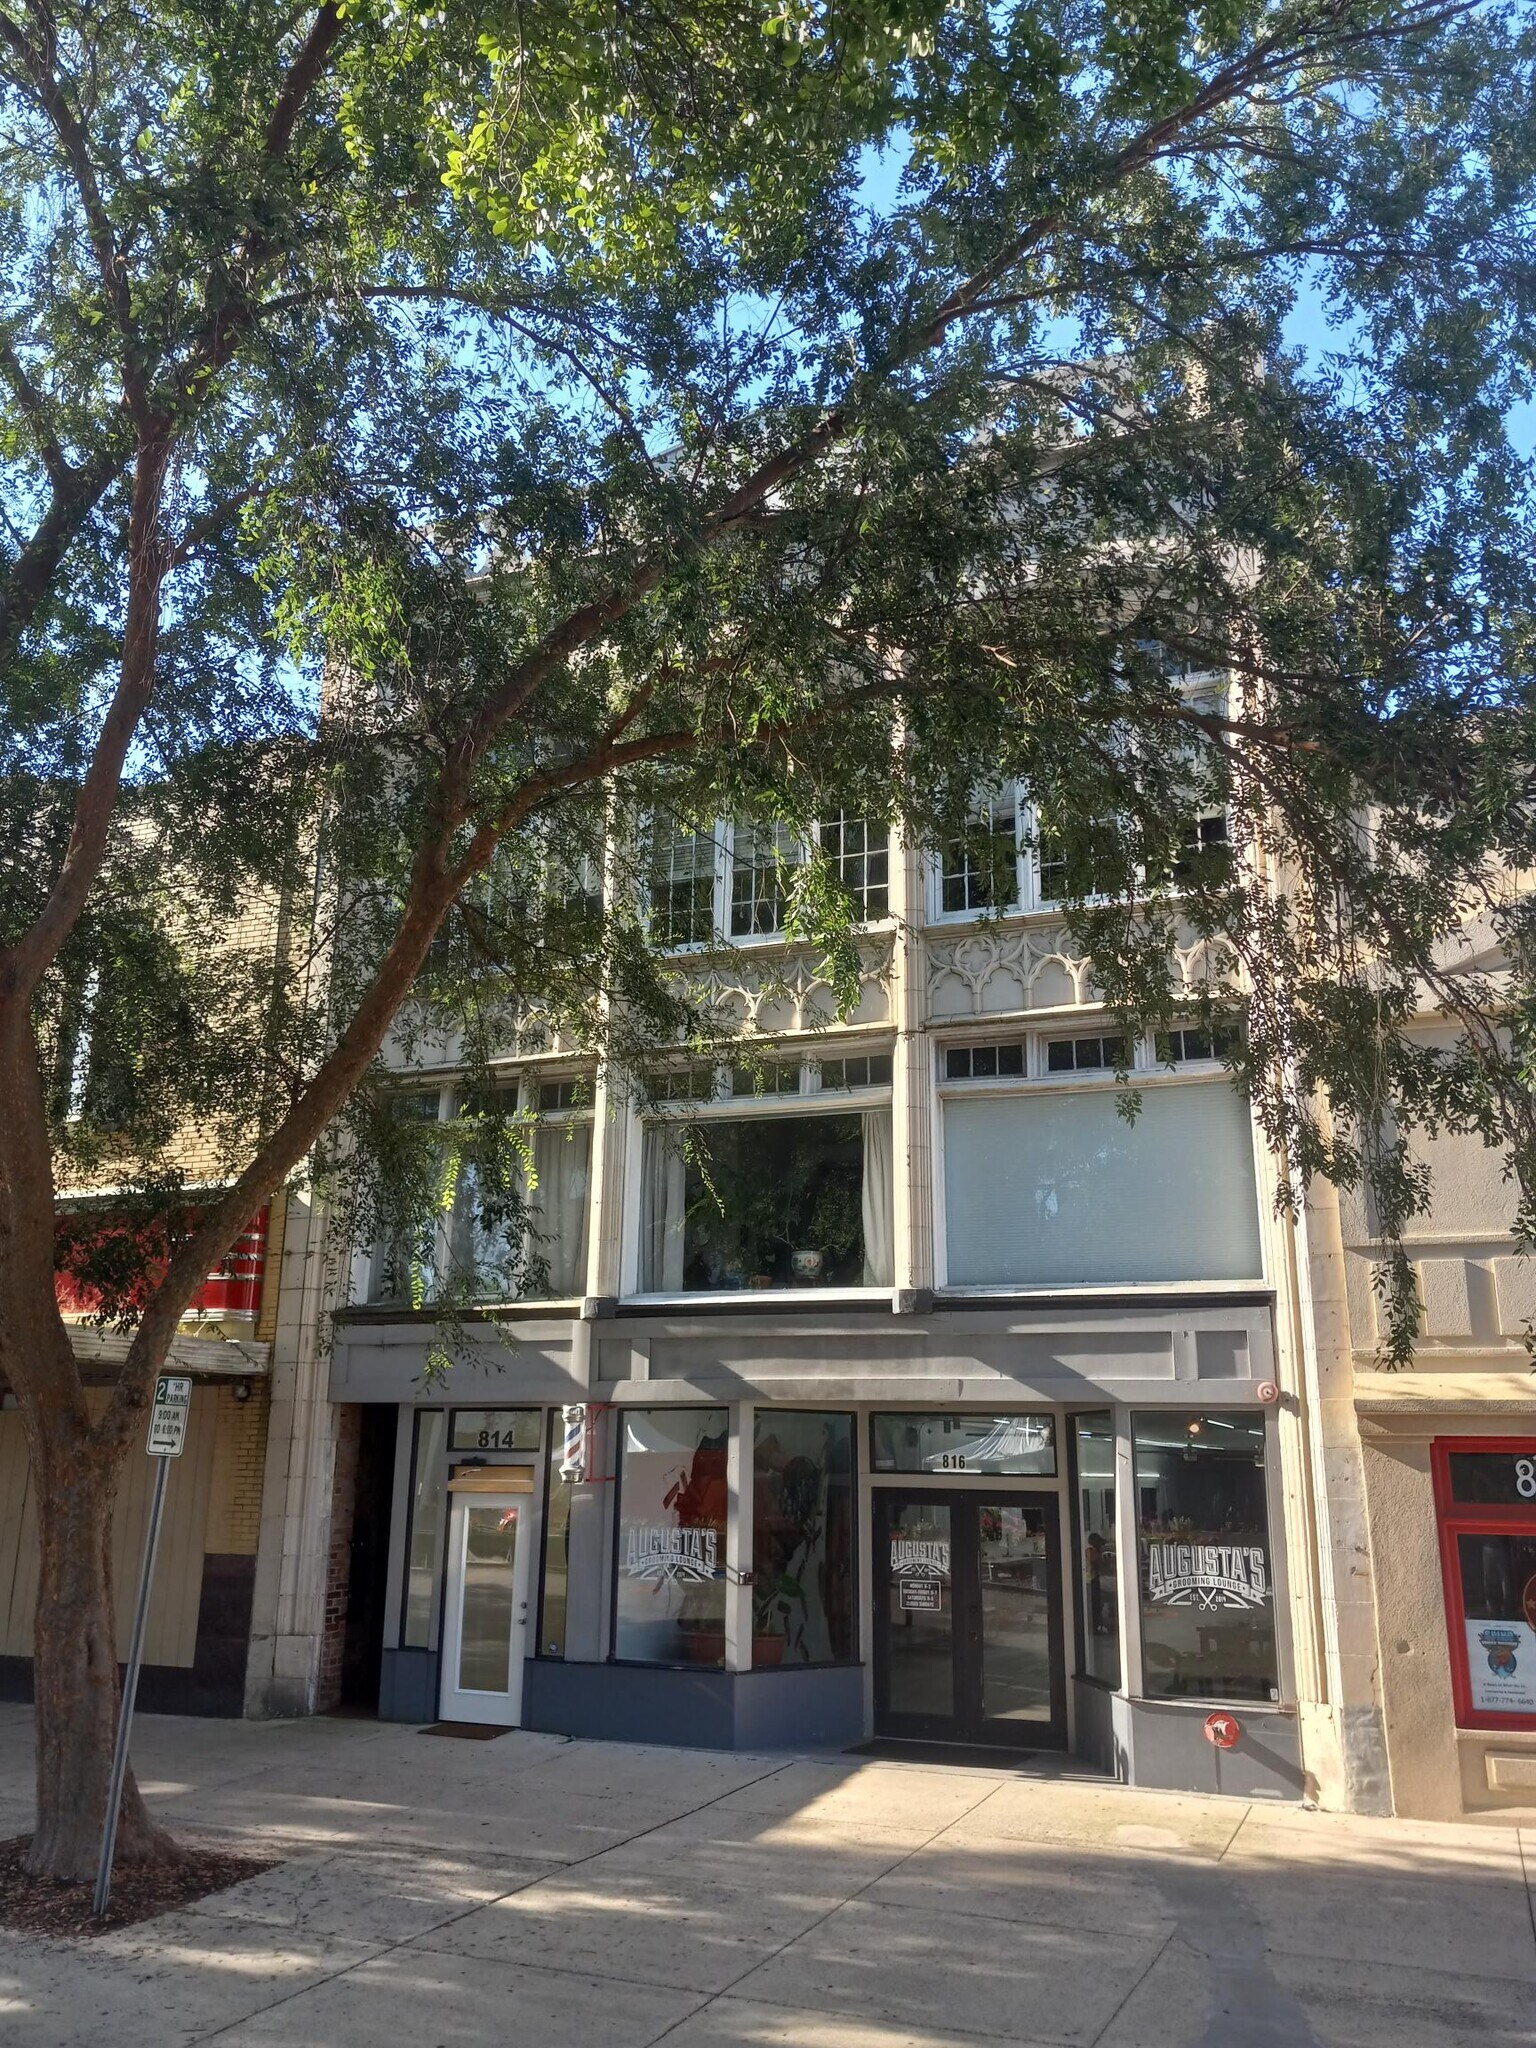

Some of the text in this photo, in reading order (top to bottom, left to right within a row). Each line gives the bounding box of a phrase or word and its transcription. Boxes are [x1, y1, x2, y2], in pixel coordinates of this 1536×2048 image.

[156, 1381, 184, 1400] 2 HR
[166, 1393, 188, 1404] PARKING
[172, 1410, 180, 1421] AM
[173, 1425, 181, 1435] PM
[478, 1430, 514, 1448] 814
[942, 1454, 966, 1469] 816
[627, 1527, 718, 1569] AUGUSTA'S
[890, 1540, 951, 1568] AUGUSTA'S
[645, 1554, 699, 1569] GROOMING LOUNGE
[1149, 1543, 1266, 1593] AUGUSTA'S
[1172, 1577, 1241, 1591] GROOMING LOUNGE
